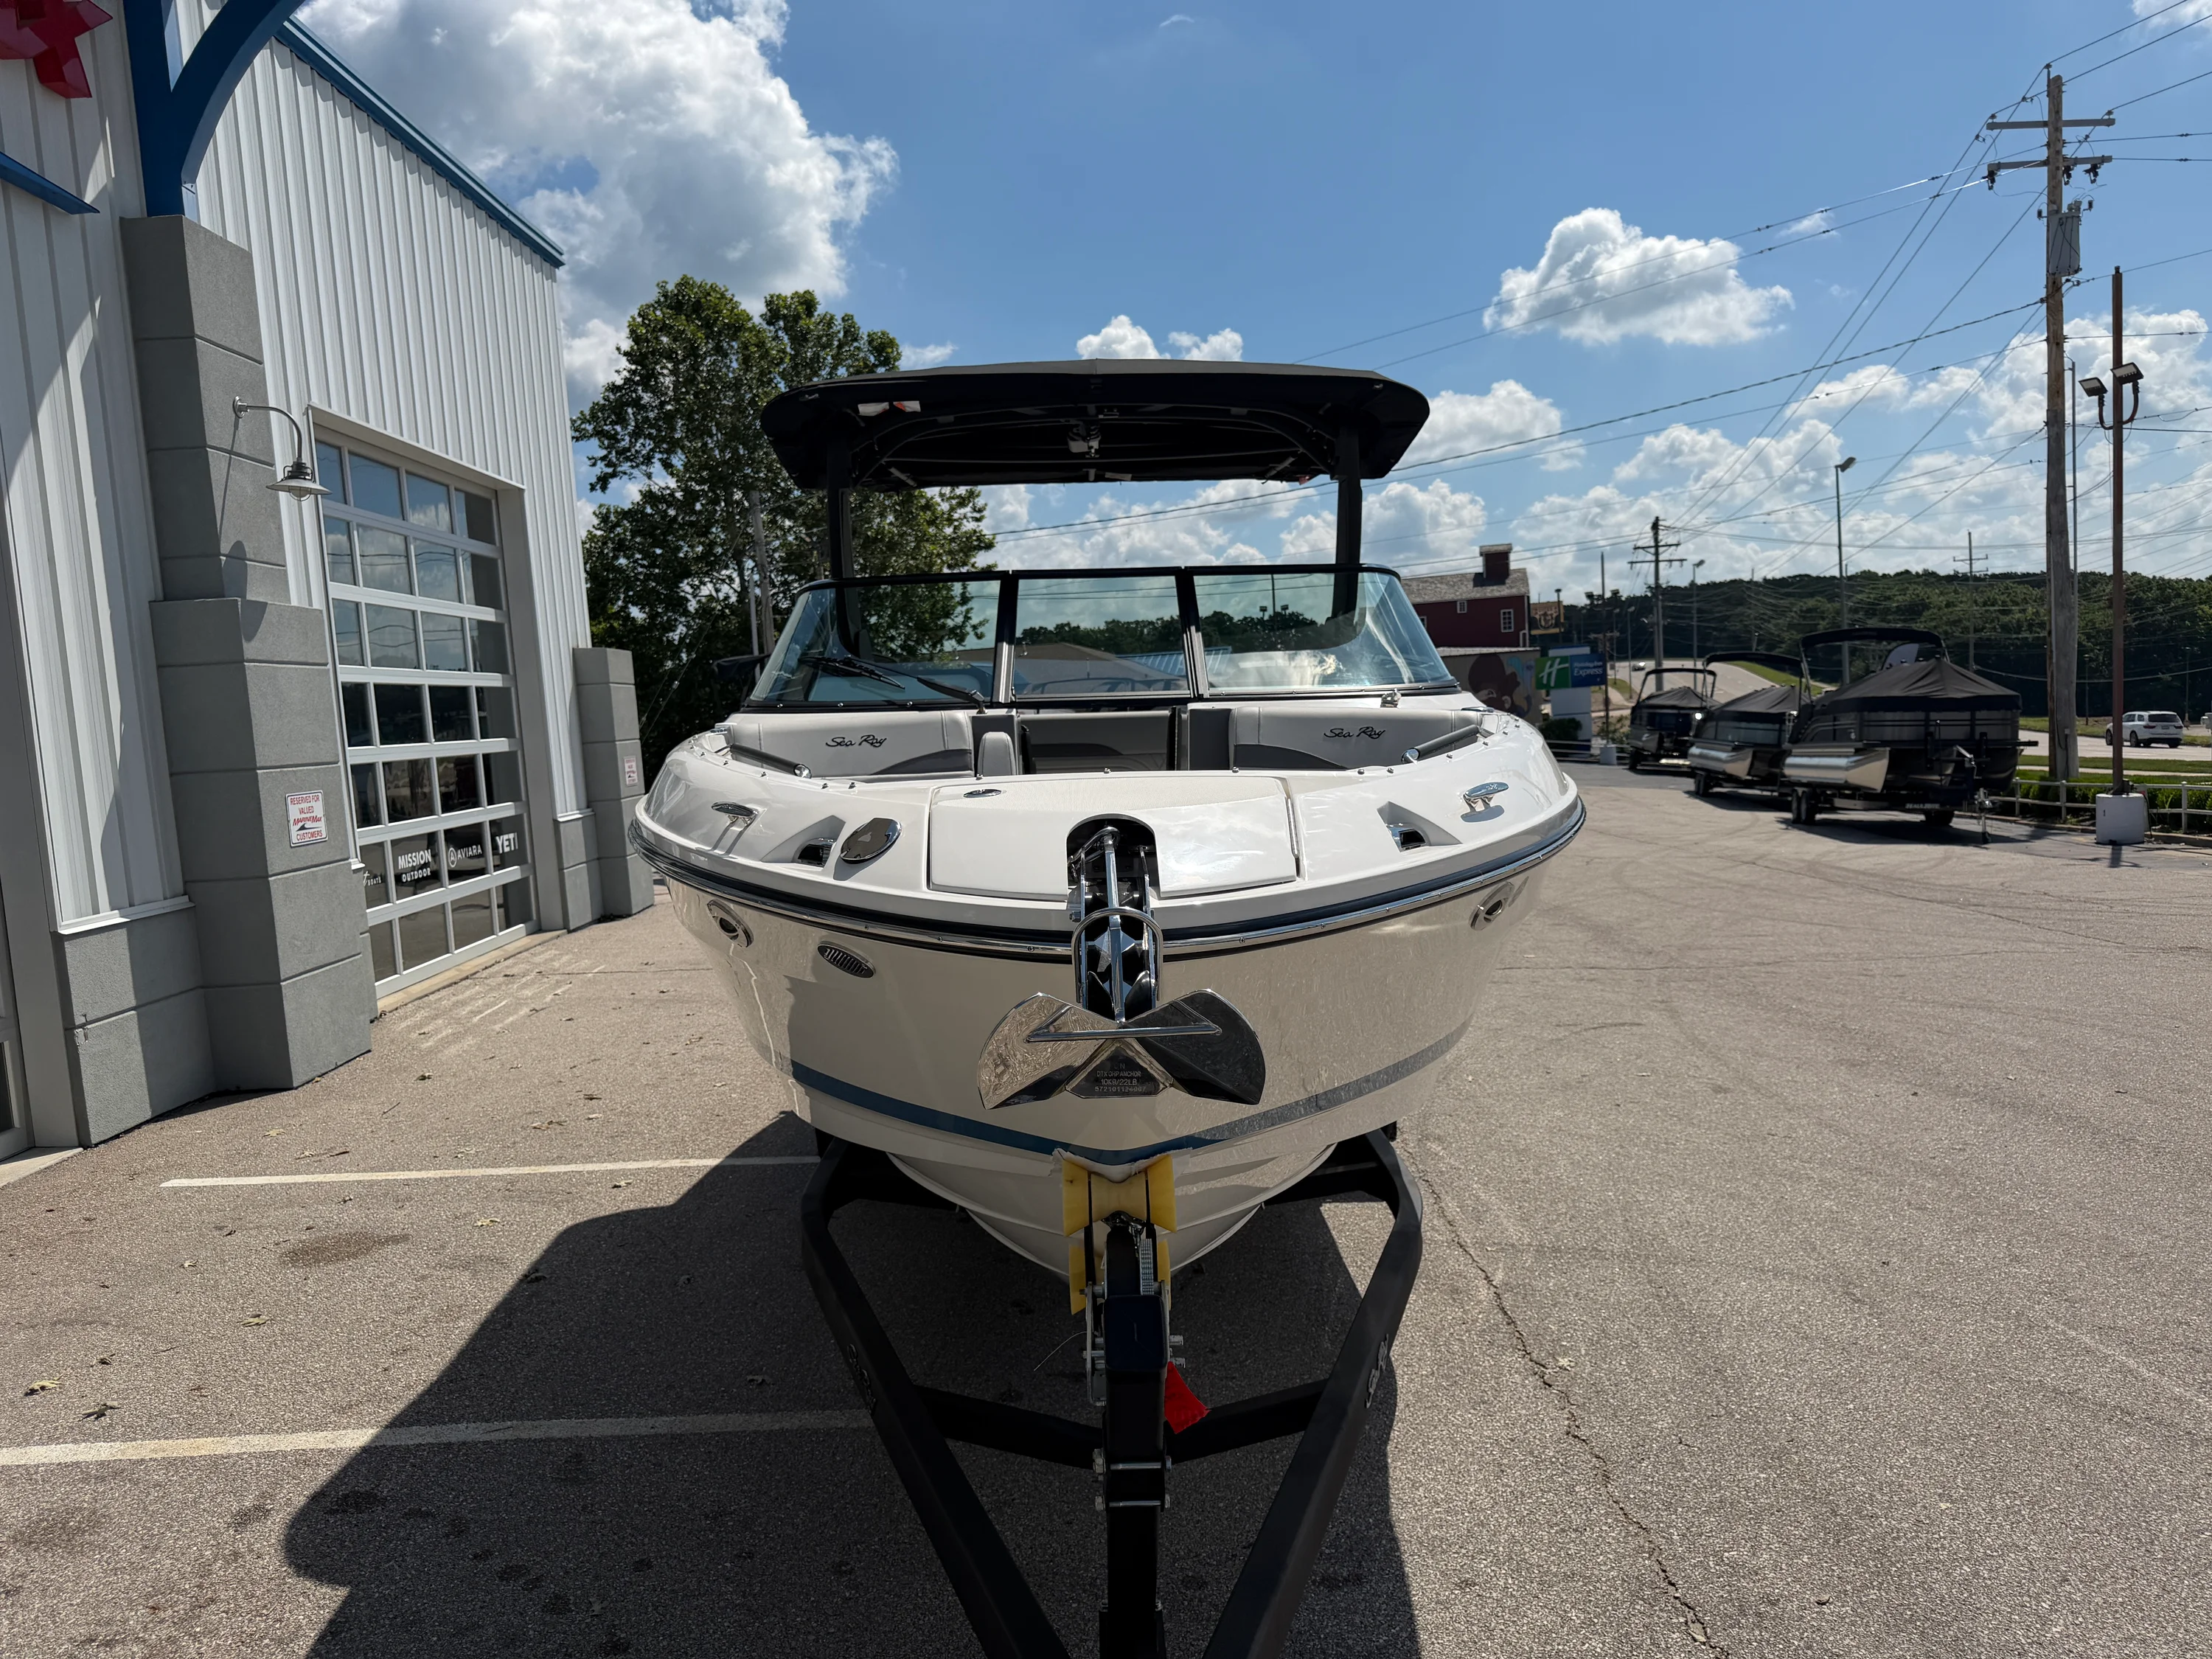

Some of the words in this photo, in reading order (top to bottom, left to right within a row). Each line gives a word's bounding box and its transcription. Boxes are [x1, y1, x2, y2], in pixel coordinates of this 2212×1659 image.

[1573, 668, 1603, 678] Express
[1324, 728, 1354, 738] Sea
[1356, 726, 1386, 740] Ray
[825, 737, 856, 748] Sea
[858, 734, 887, 748] Ray
[290, 796, 311, 805] RESERVED
[312, 794, 320, 803] FOR
[299, 806, 315, 815] VALUED
[296, 830, 323, 841] CUSTOMERS
[495, 832, 519, 854] YETI
[457, 844, 483, 860] AVIARA
[398, 849, 432, 870] MISSION
[402, 868, 431, 883] OUTDOOR
